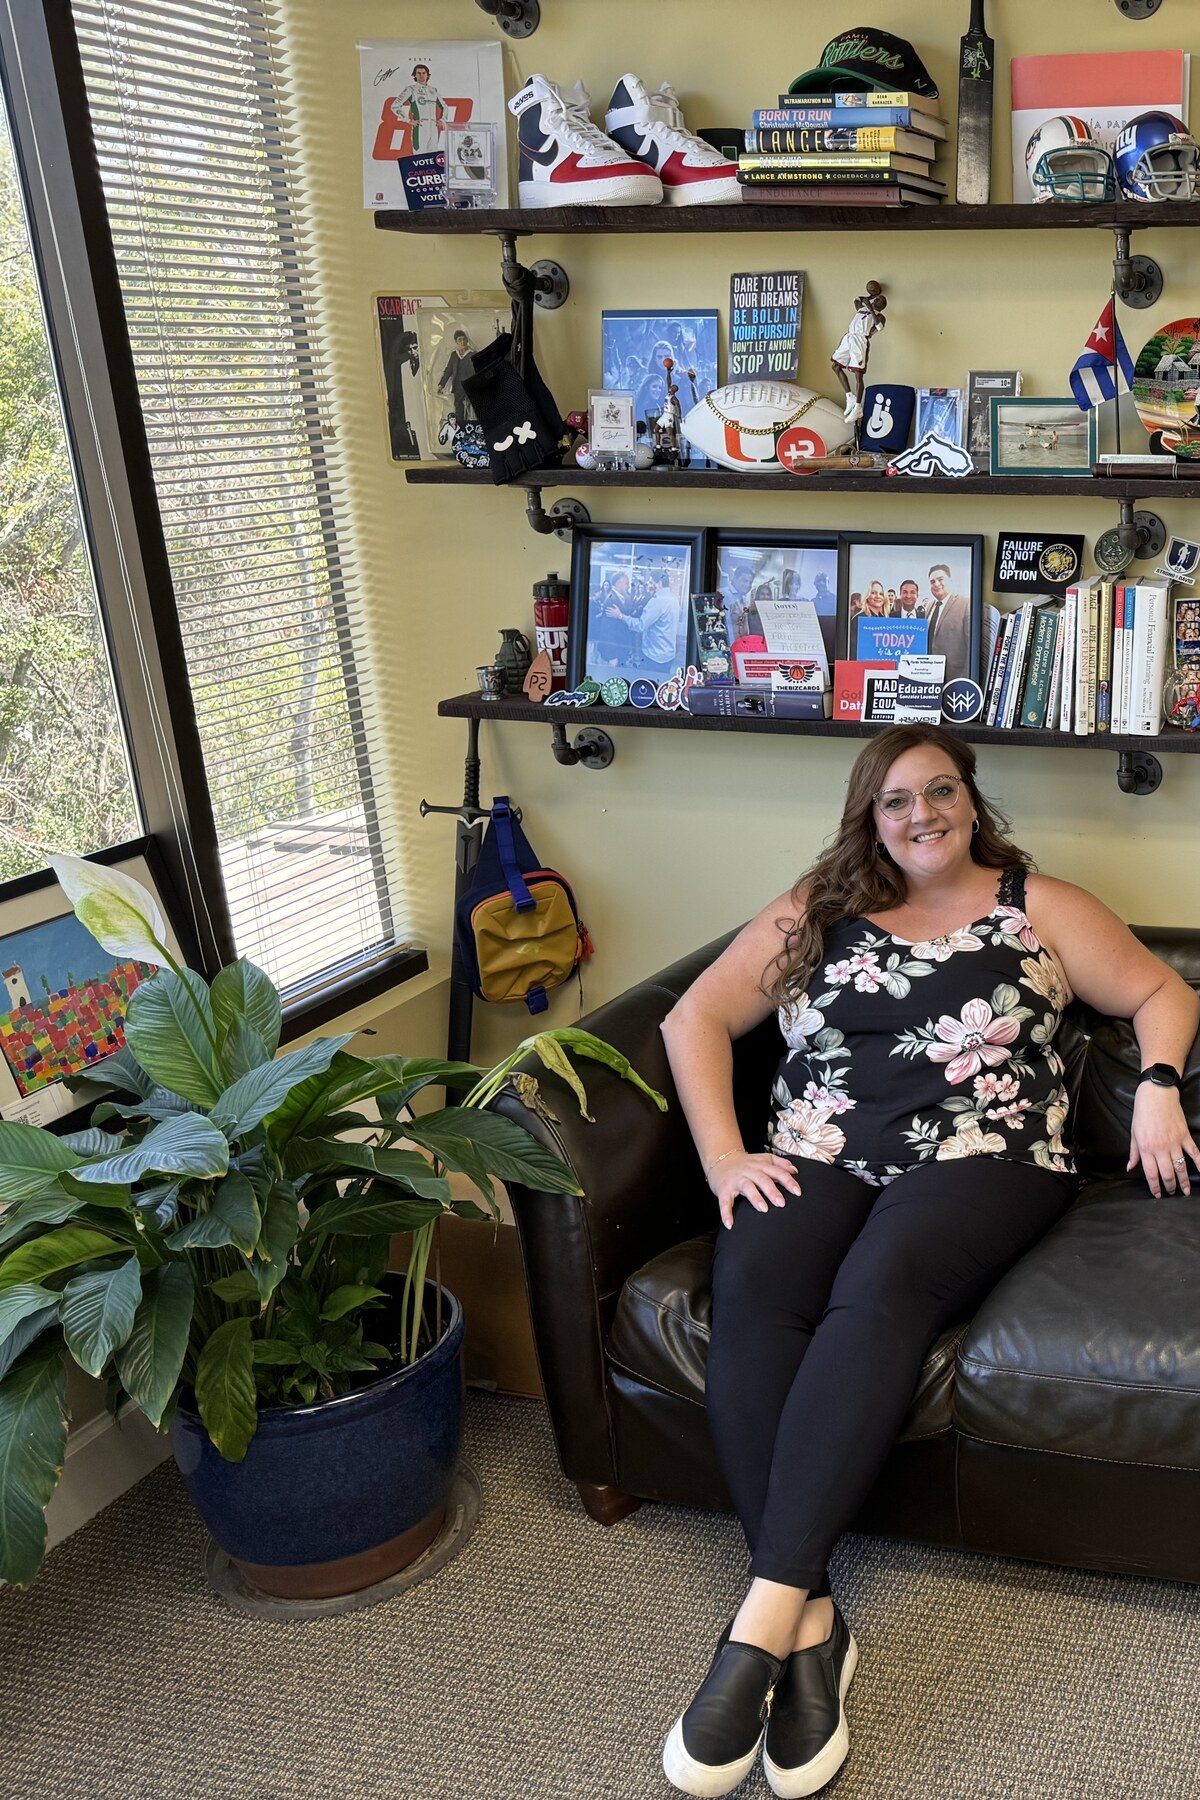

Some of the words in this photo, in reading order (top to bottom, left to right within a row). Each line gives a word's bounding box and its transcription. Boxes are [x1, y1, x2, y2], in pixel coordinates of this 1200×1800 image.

[821, 40, 904, 69] Rattlers
[759, 110, 787, 121] BORN
[792, 110, 806, 120] TO
[808, 110, 832, 120] RUN
[760, 130, 822, 152] LANCE
[413, 158, 434, 166] VOTE
[734, 276, 758, 292] DARE
[761, 276, 774, 292] TO
[777, 275, 798, 292] LIVE
[734, 292, 758, 308] YOUR
[760, 291, 798, 307] DREAMS
[734, 310, 747, 324] BE
[752, 308, 780, 324] BOLD
[785, 308, 797, 322] IN
[733, 326, 757, 340] YOUR
[758, 324, 798, 340] PURSUIT
[732, 341, 753, 352] DON'T
[755, 340, 767, 352] LET
[768, 339, 796, 351] ANYONE
[733, 354, 764, 374] STOP
[768, 352, 795, 372] YOU.
[1003, 540, 1043, 552] FAILURE
[1002, 551, 1012, 560] IS
[1014, 551, 1034, 561] NOT
[1000, 560, 1016, 570] AN
[1000, 570, 1038, 581] OPTION
[1149, 594, 1157, 622] Personal
[1037, 616, 1047, 643] Modern
[872, 633, 915, 648] TODAY
[1146, 624, 1155, 654] Financial
[1031, 646, 1042, 686] Portuguese
[1143, 656, 1153, 684] Planning
[874, 680, 897, 692] MAD
[899, 684, 941, 694] Eduardo
[992, 687, 1000, 705] GODIN
